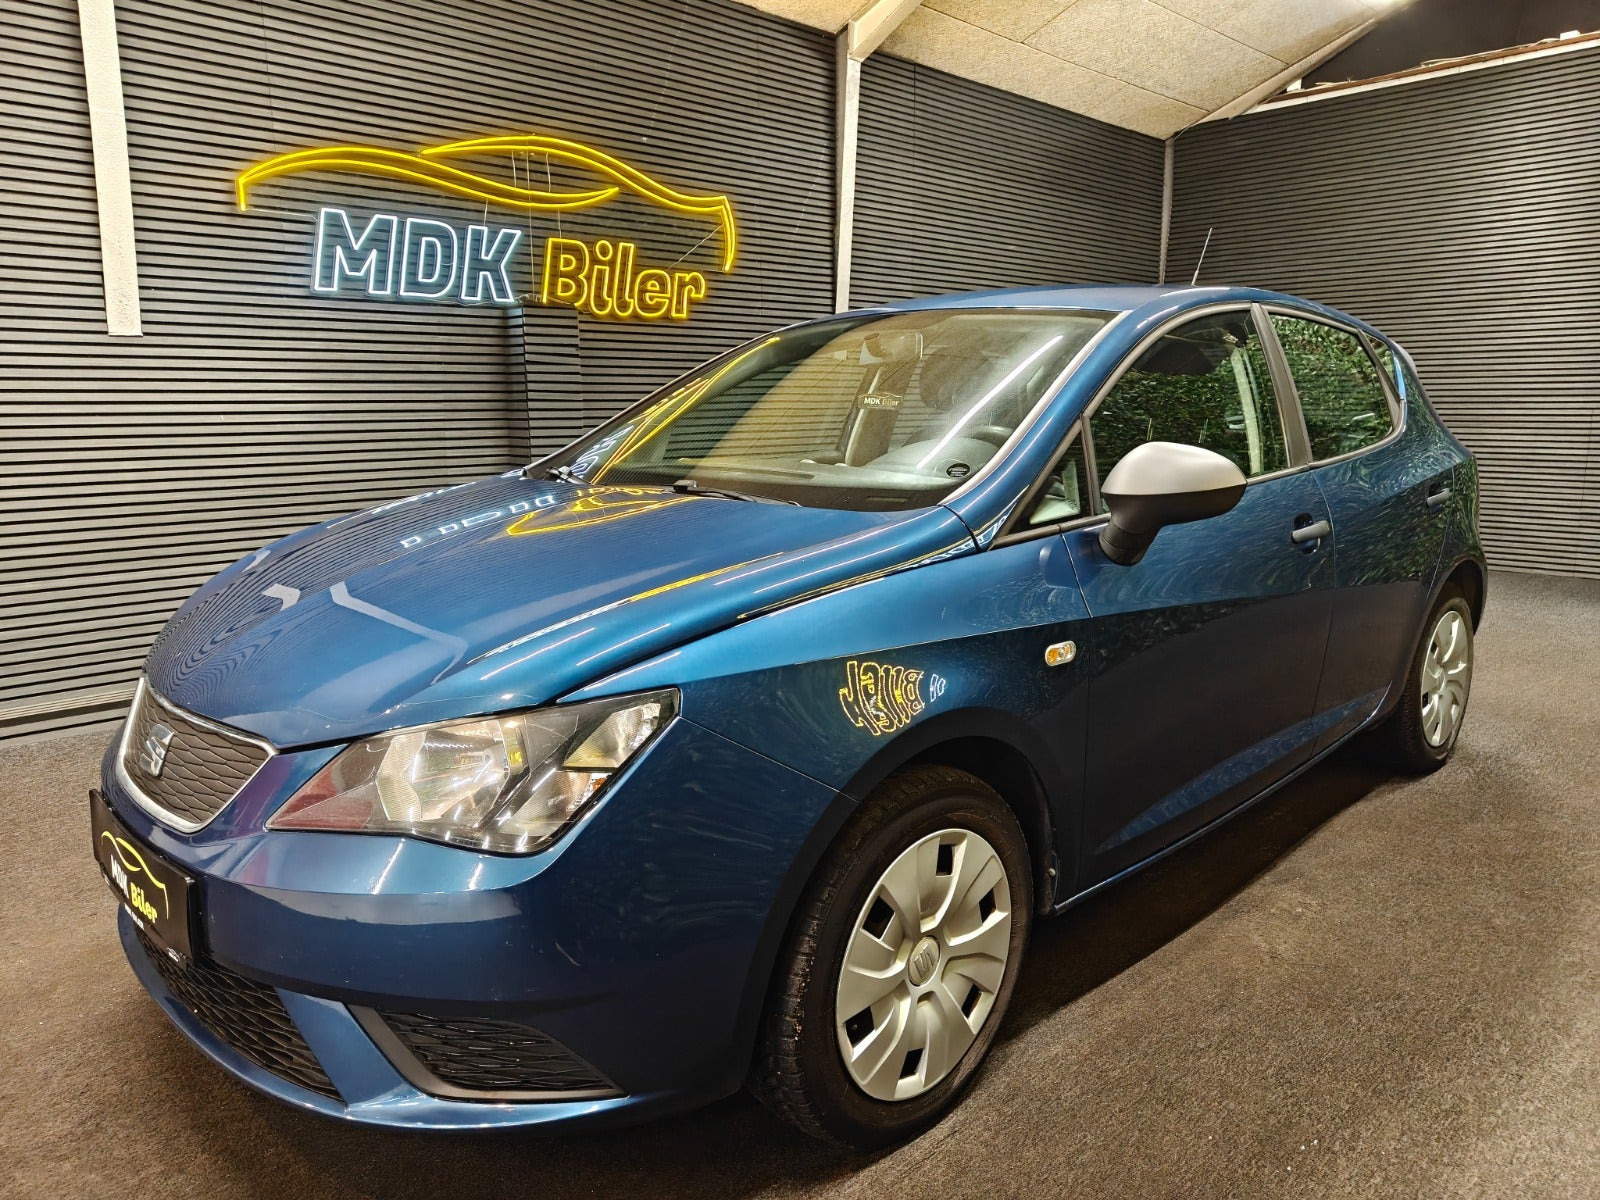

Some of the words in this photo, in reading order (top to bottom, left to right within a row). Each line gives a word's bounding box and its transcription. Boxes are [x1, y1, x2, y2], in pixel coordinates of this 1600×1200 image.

[313, 207, 522, 303] MDK
[542, 237, 706, 319] Biler
[110, 854, 130, 899] MDK
[130, 881, 158, 924] Biler
